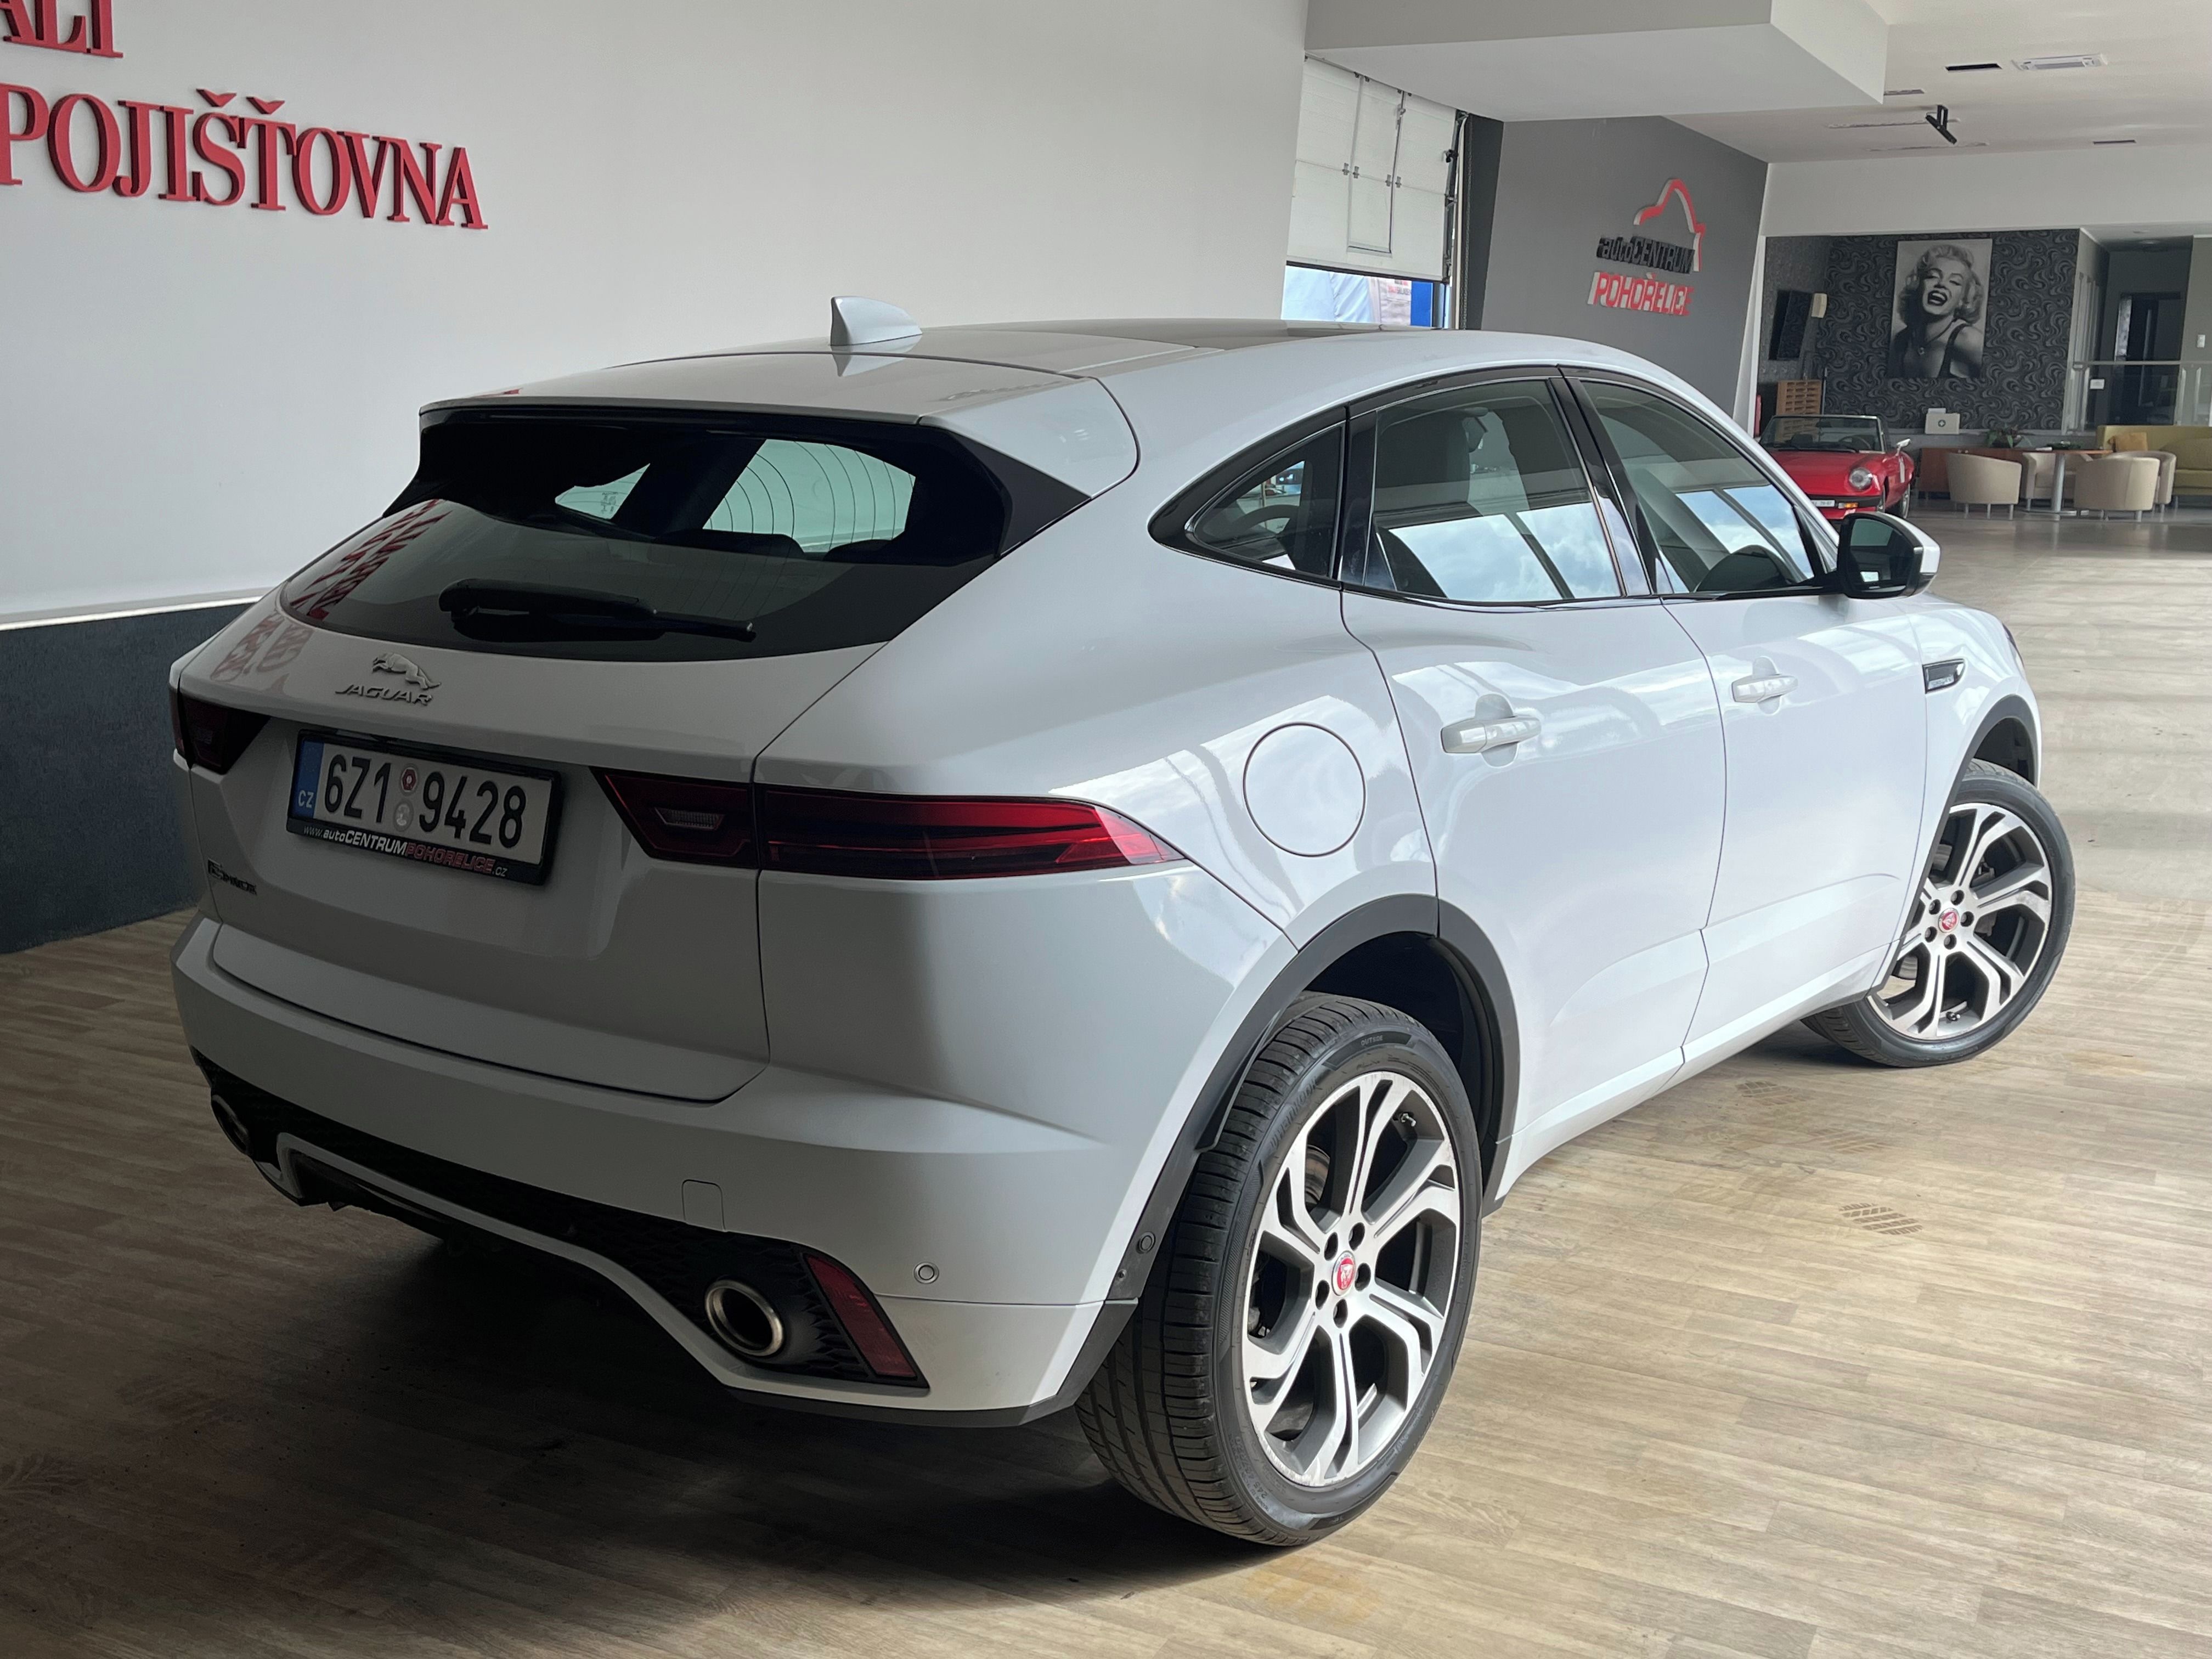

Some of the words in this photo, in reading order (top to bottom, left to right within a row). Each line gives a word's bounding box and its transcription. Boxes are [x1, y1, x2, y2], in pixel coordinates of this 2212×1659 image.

[0, 82, 488, 229] POJIŠŤOVNA
[1596, 234, 1695, 274] autoCENTRUM
[335, 684, 433, 707] JAGUAR
[297, 789, 314, 809] CZ
[324, 754, 392, 823] 6Z1
[419, 771, 526, 849] 9428
